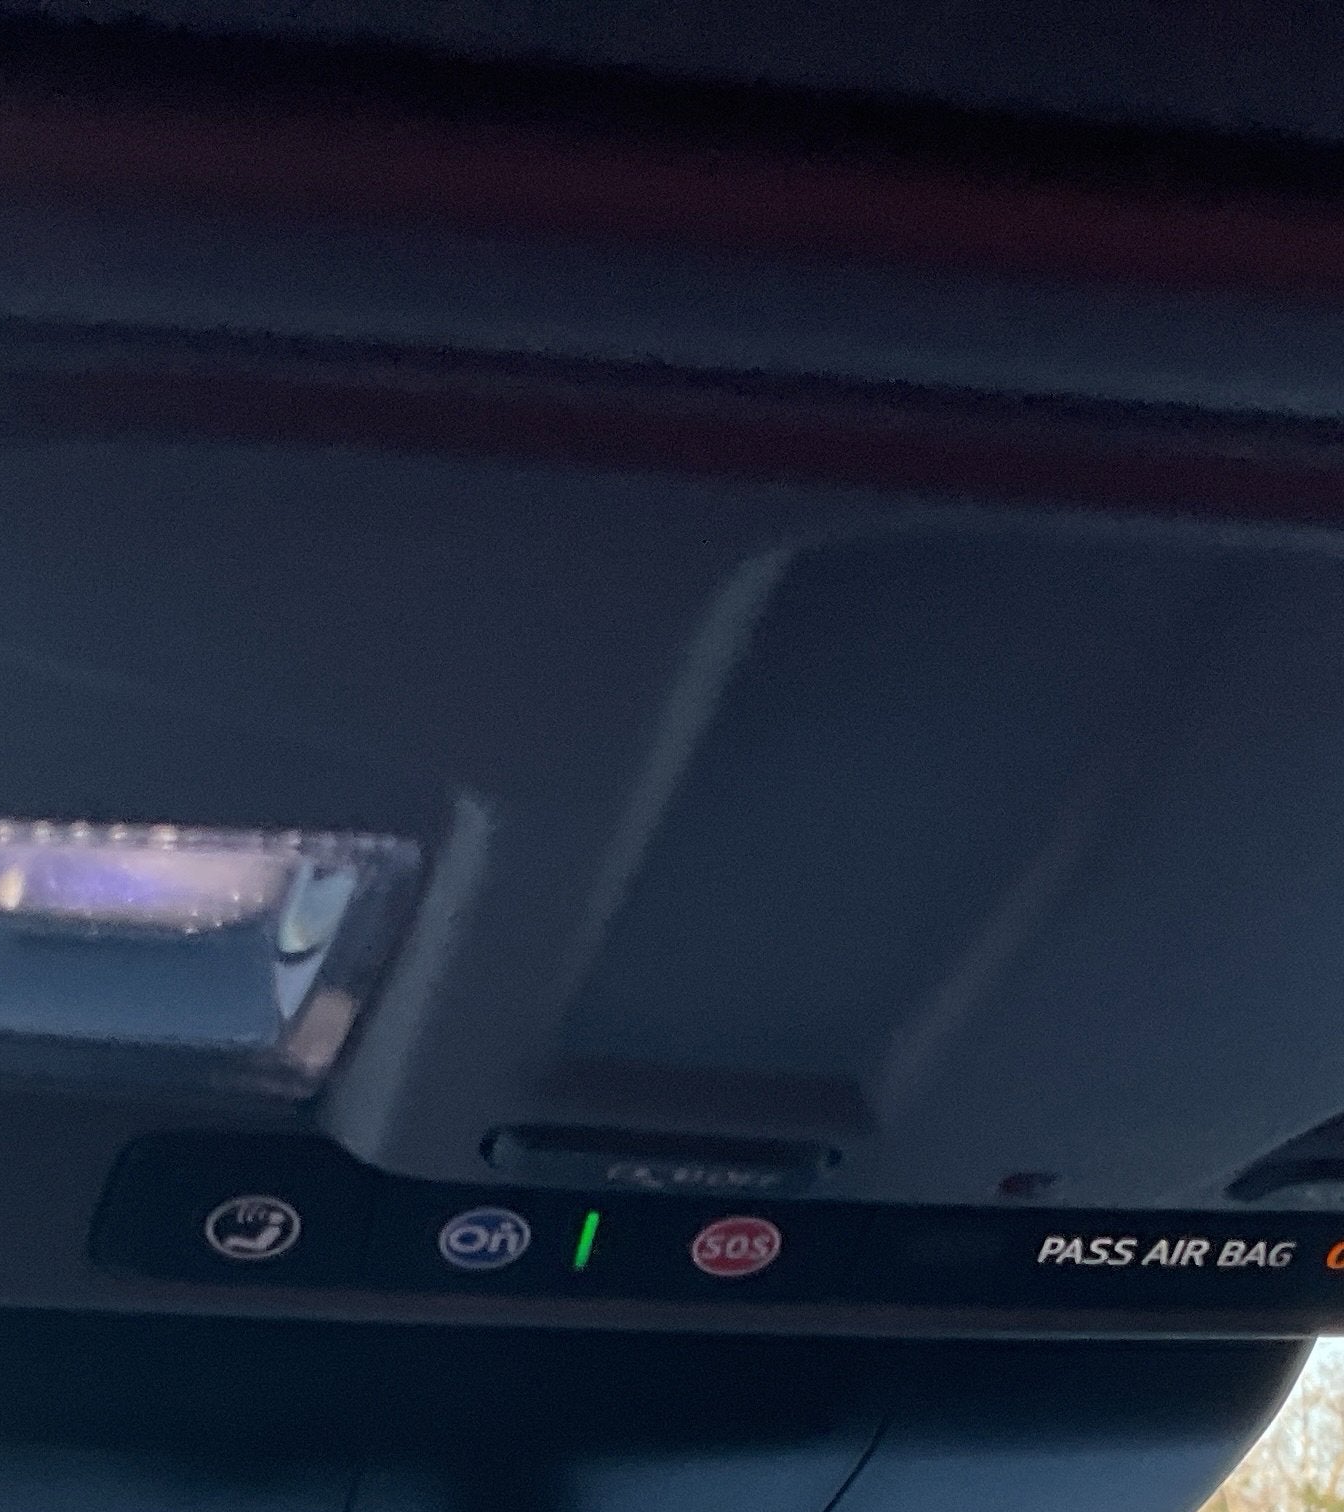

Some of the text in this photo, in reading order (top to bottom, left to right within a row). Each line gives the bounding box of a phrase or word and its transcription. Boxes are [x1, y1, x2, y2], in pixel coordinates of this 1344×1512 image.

[449, 1222, 520, 1256] On
[702, 1233, 772, 1260] SOS
[1038, 1237, 1138, 1266] PASS
[1142, 1238, 1210, 1267] AIR
[1216, 1239, 1297, 1269] BAG
